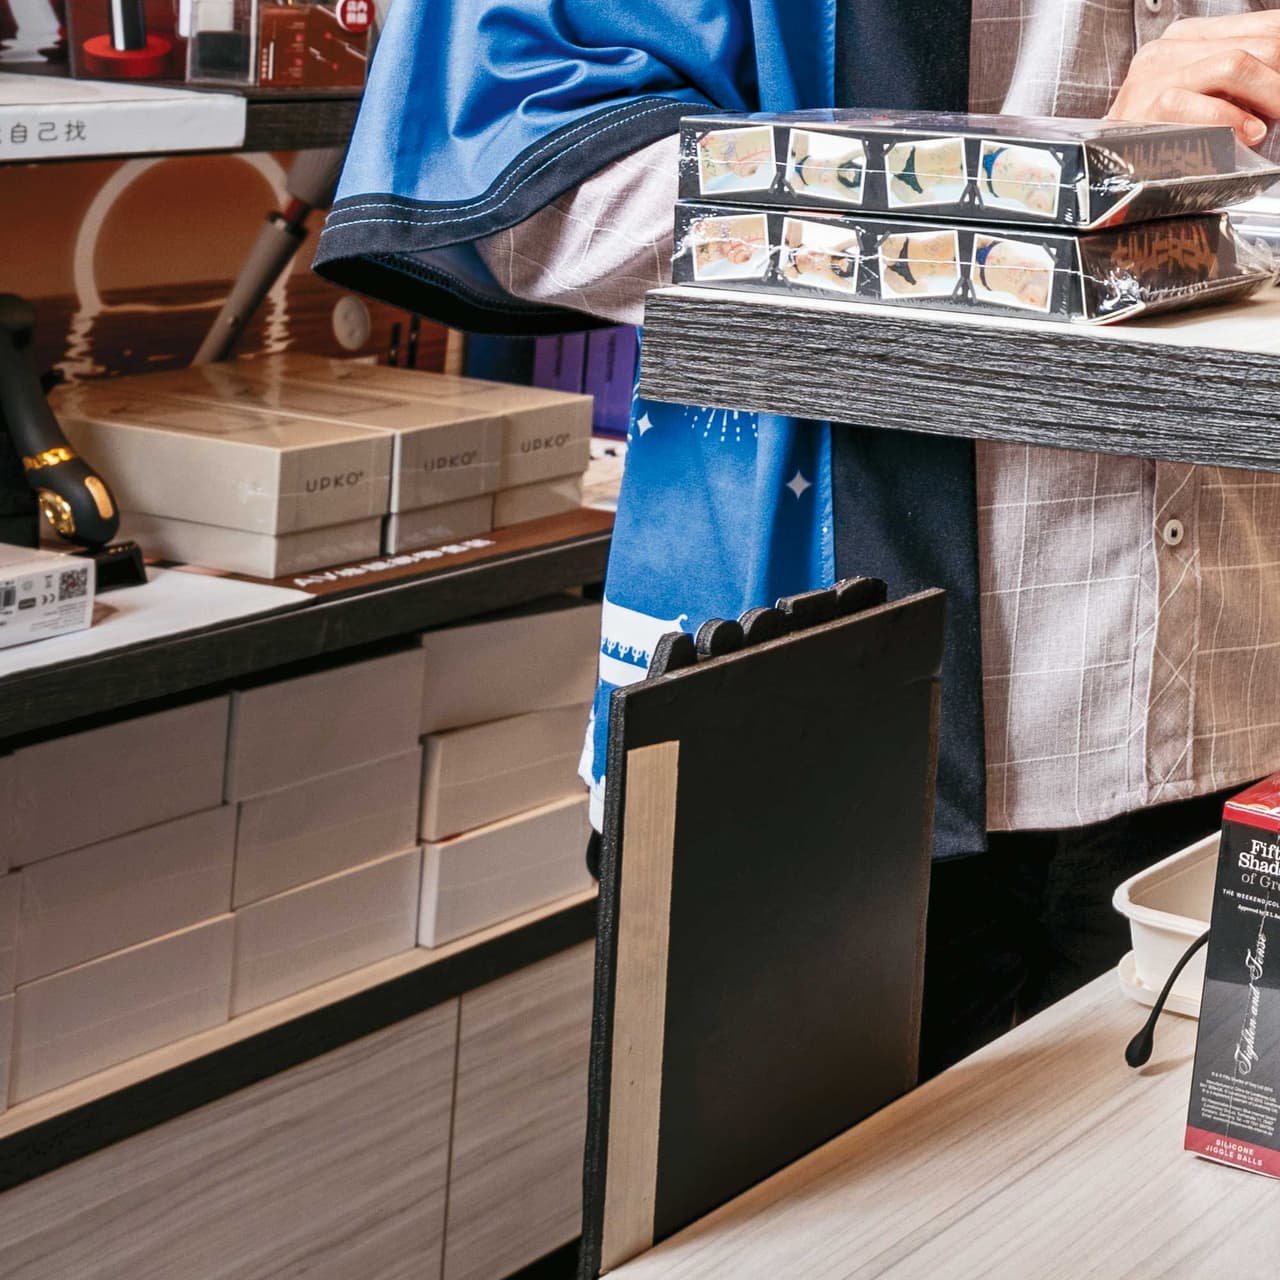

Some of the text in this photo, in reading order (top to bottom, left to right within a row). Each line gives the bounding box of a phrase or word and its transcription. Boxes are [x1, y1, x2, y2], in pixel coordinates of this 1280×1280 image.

[306, 471, 359, 494] UPKO
[1241, 872, 1257, 885] of
[1222, 888, 1235, 897] THE
[1236, 892, 1266, 905] WEEKEND
[1234, 1021, 1258, 1075] Tighten
[1249, 985, 1261, 1016] and
[1205, 1144, 1263, 1167] JIGGLE BALLS
[1215, 1138, 1255, 1156] SILICONE
